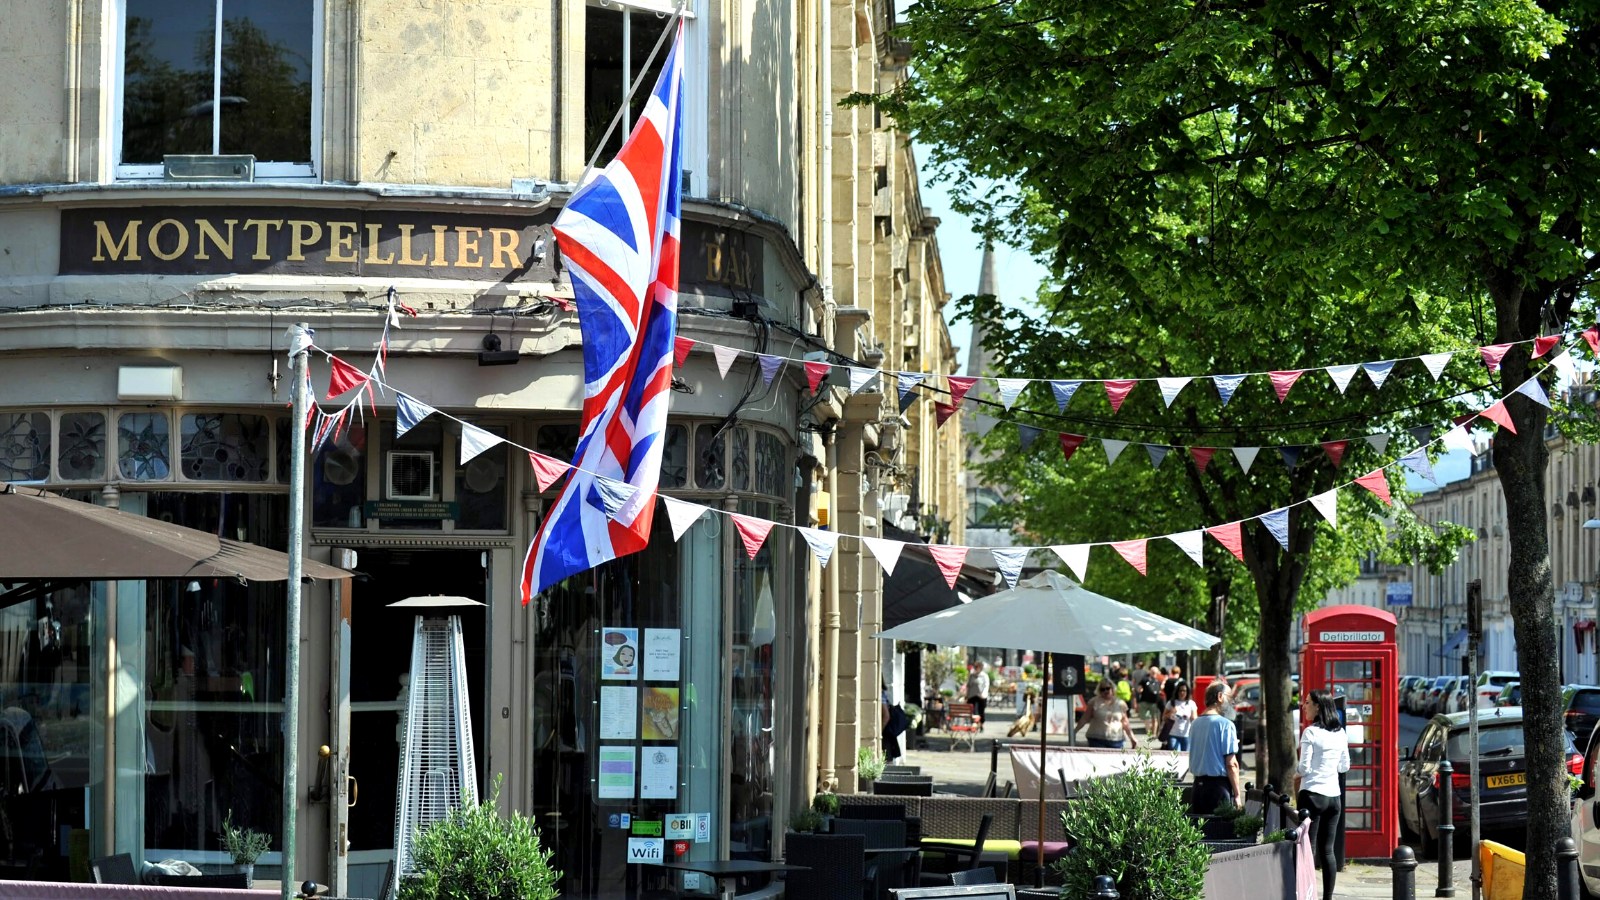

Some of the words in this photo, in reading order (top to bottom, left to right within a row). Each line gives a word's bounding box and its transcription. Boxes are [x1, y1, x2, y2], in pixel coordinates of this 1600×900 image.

[92, 218, 523, 269] MONTPELLIER
[1323, 633, 1381, 641] Defibrillator
[1491, 775, 1515, 785] VX66
[632, 848, 659, 858] Wifi
